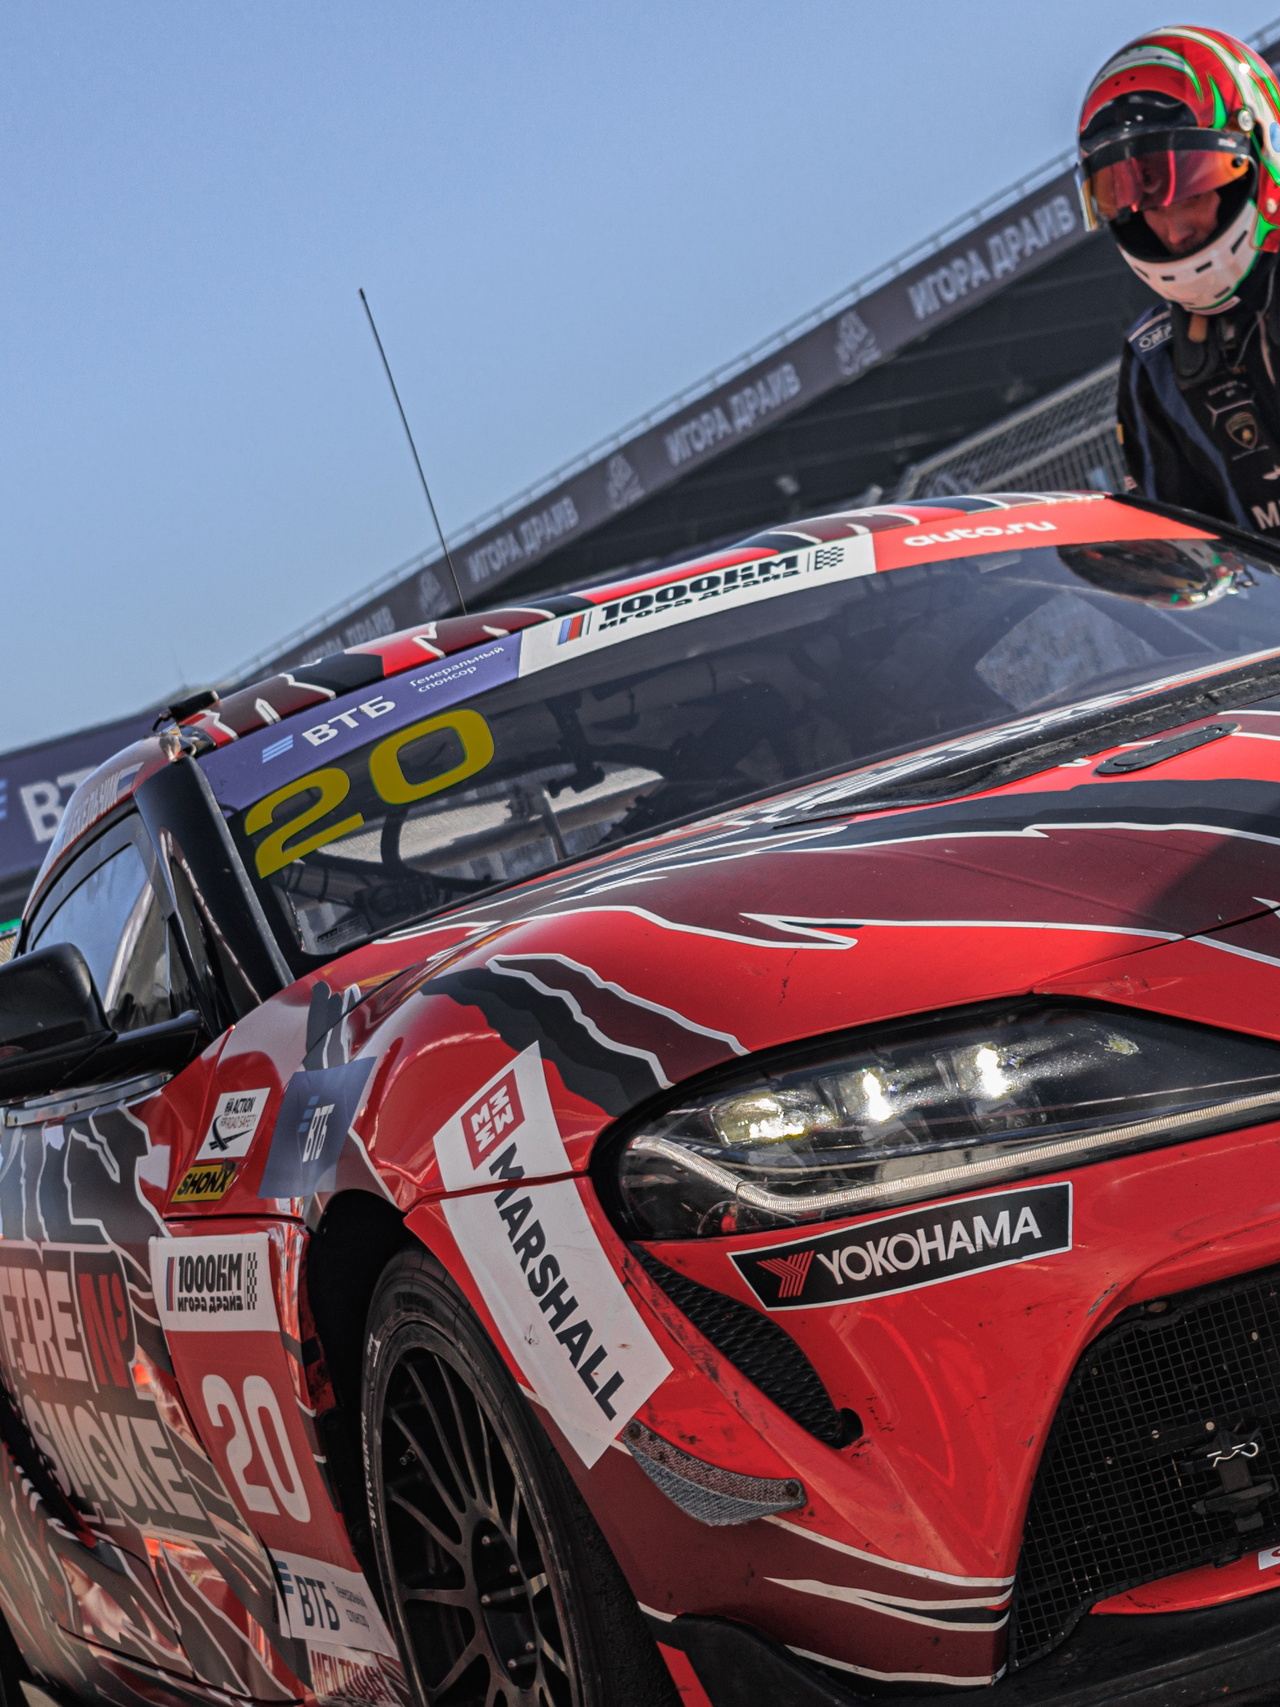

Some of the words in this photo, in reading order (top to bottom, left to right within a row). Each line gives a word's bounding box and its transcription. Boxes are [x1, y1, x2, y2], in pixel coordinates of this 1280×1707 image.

[903, 520, 1058, 547] auto.ru
[409, 645, 504, 688] Генеральный
[418, 664, 477, 693] спонсор
[301, 695, 397, 747] ВТБ
[244, 708, 495, 879] 20
[302, 1103, 336, 1163] ВТБ
[817, 1206, 1043, 1285] YOKOHAMA
[489, 1142, 625, 1421] MARSHALL
[23, 1393, 207, 1522] SMOKE
[202, 1373, 312, 1524] 20
[294, 1574, 341, 1632] ВТБ
